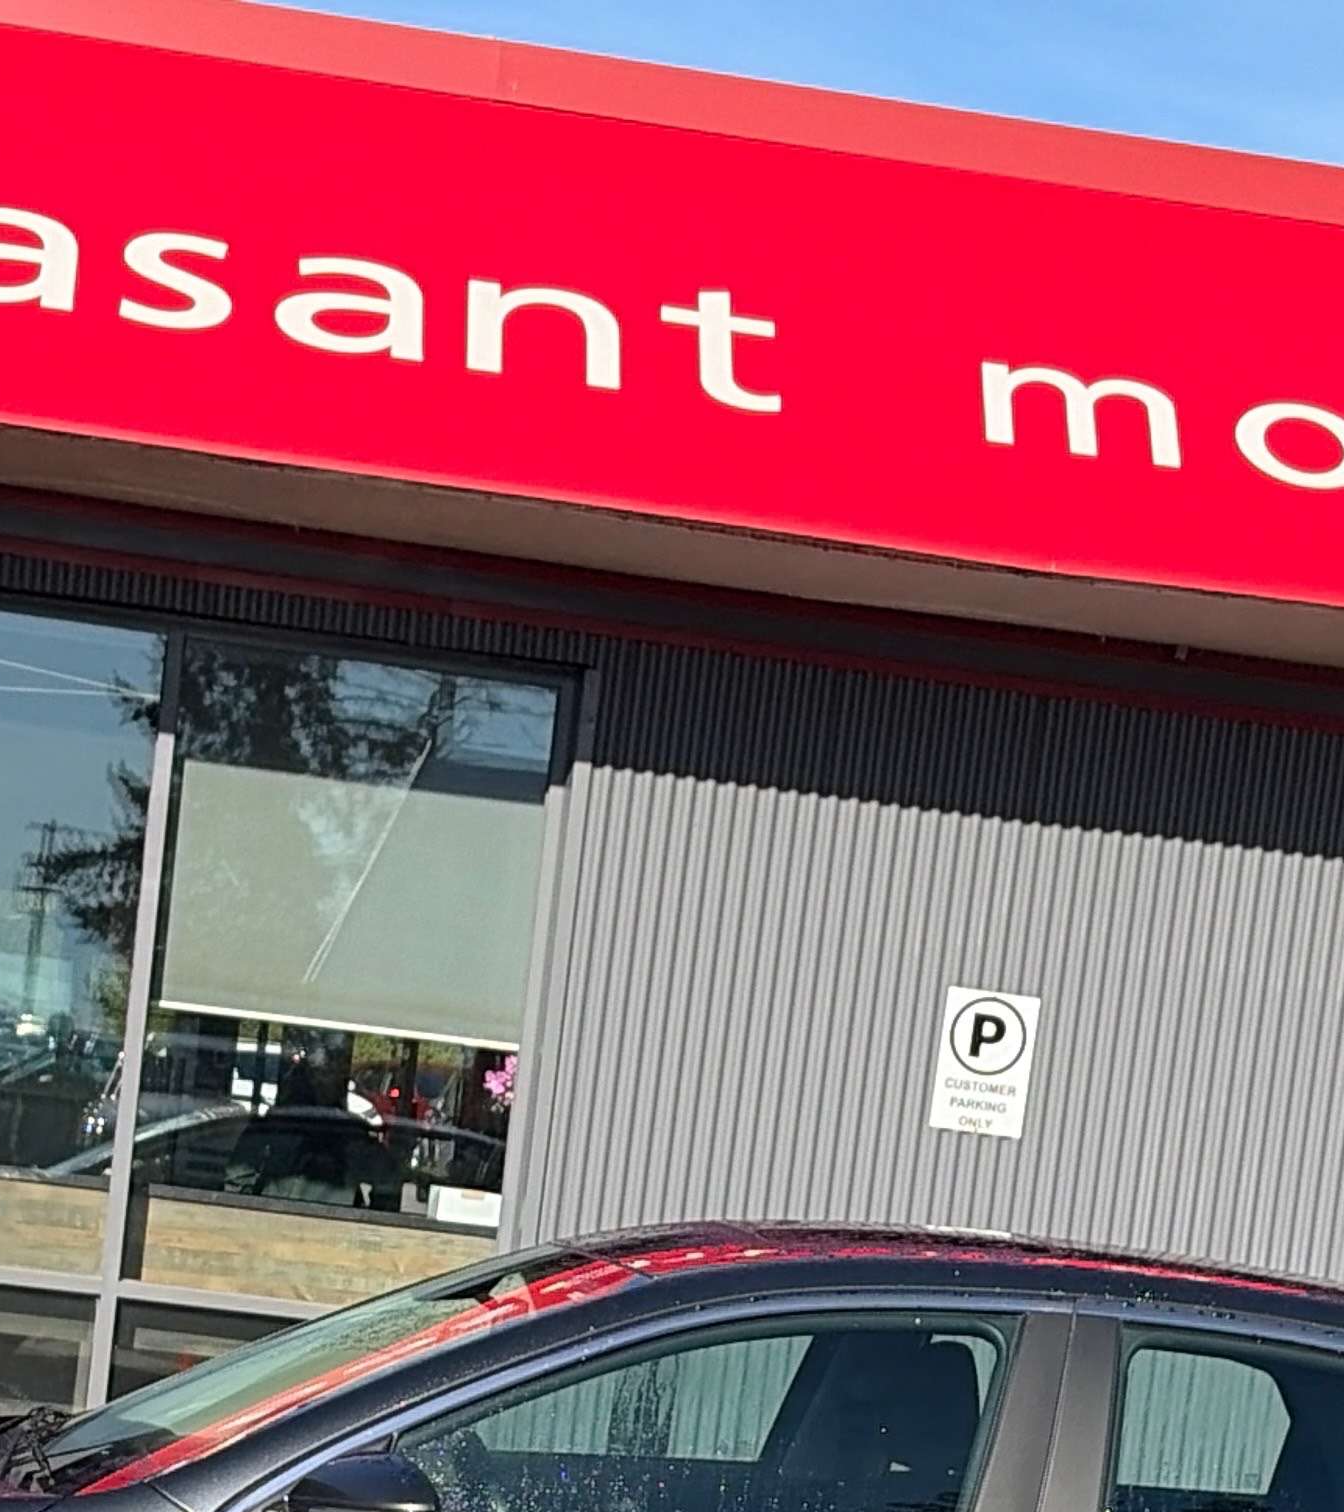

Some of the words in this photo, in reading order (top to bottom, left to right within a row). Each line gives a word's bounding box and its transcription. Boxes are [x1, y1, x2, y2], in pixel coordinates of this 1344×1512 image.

[968, 1012, 1006, 1058] P
[944, 1077, 1016, 1097] CUSTOMER
[949, 1096, 1007, 1113] PARKING
[958, 1115, 992, 1128] ONLY
